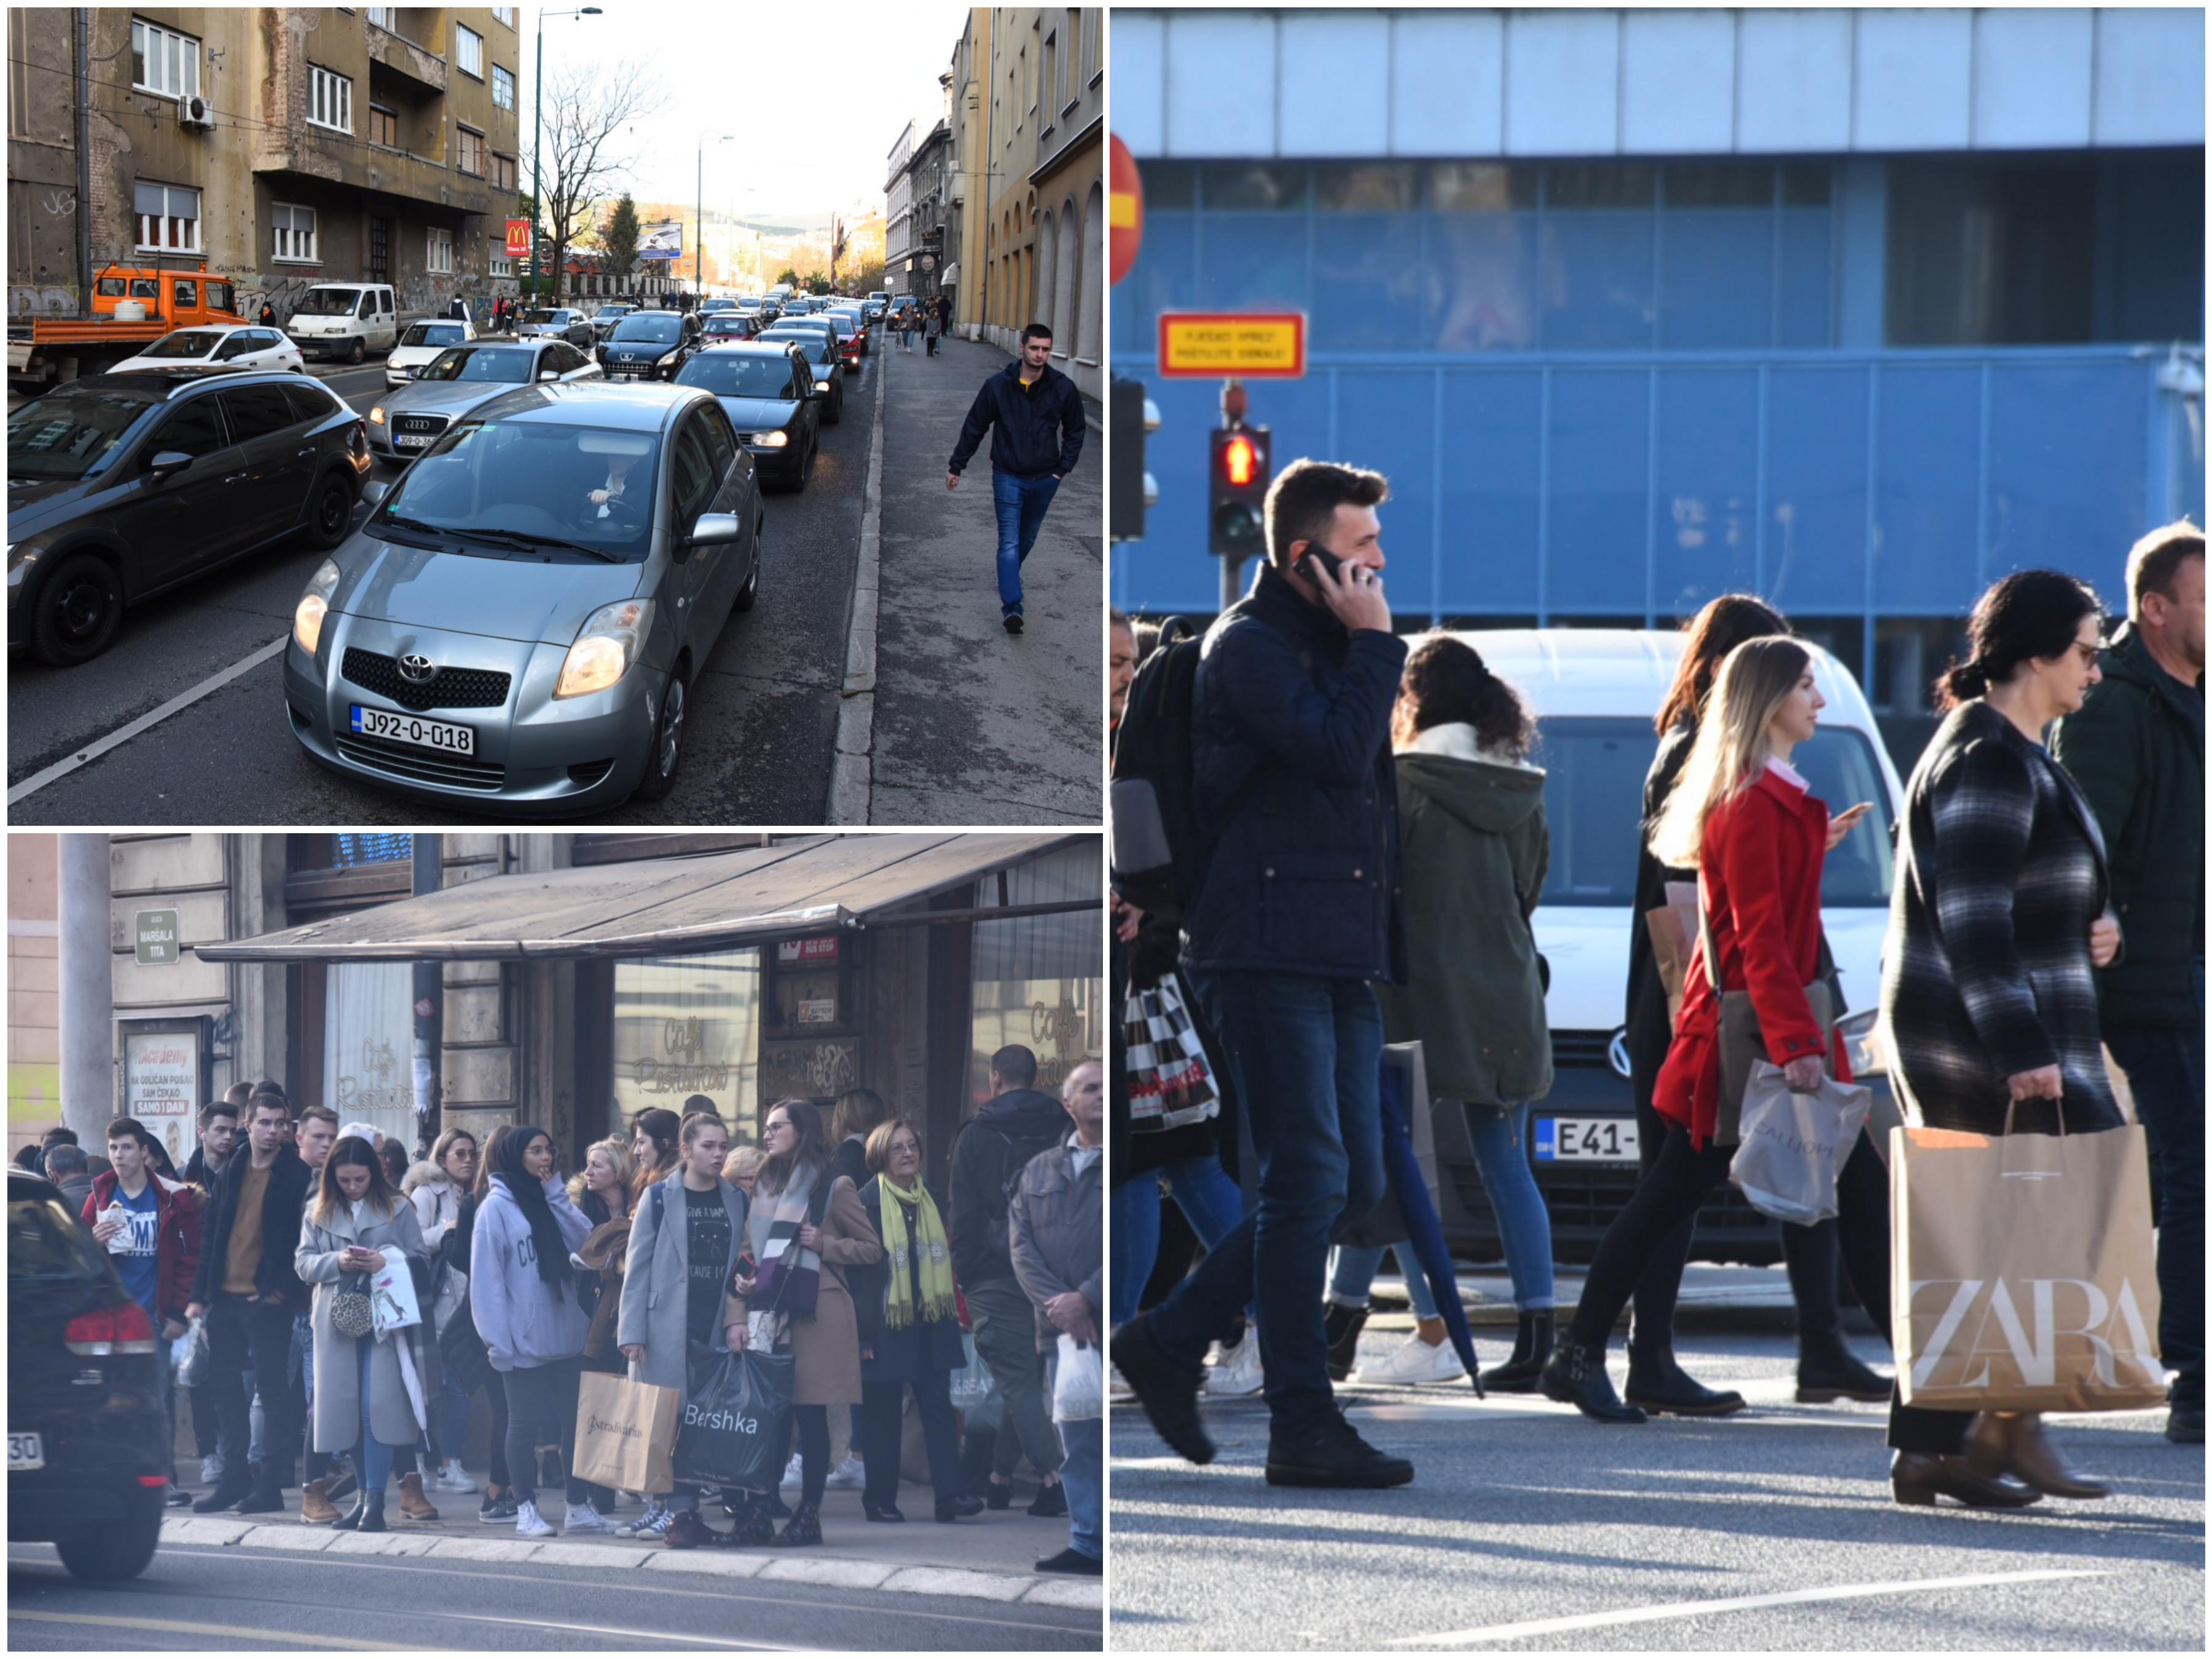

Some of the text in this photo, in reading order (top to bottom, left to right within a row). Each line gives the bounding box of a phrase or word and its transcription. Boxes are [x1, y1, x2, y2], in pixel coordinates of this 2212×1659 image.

[140, 927, 173, 943] MARŠALA
[149, 946, 165, 957] TITA
[141, 1073, 168, 1085] ODLIČAN
[170, 1075, 194, 1084] POSAO
[633, 1057, 728, 1094] Restaurant
[142, 1086, 180, 1098] SAM ČEKAO
[137, 1101, 184, 1114] SAMO 1 DAN
[704, 1207, 709, 1217] A
[1910, 1276, 2167, 1389] ZARA
[684, 1403, 758, 1435] Bershka
